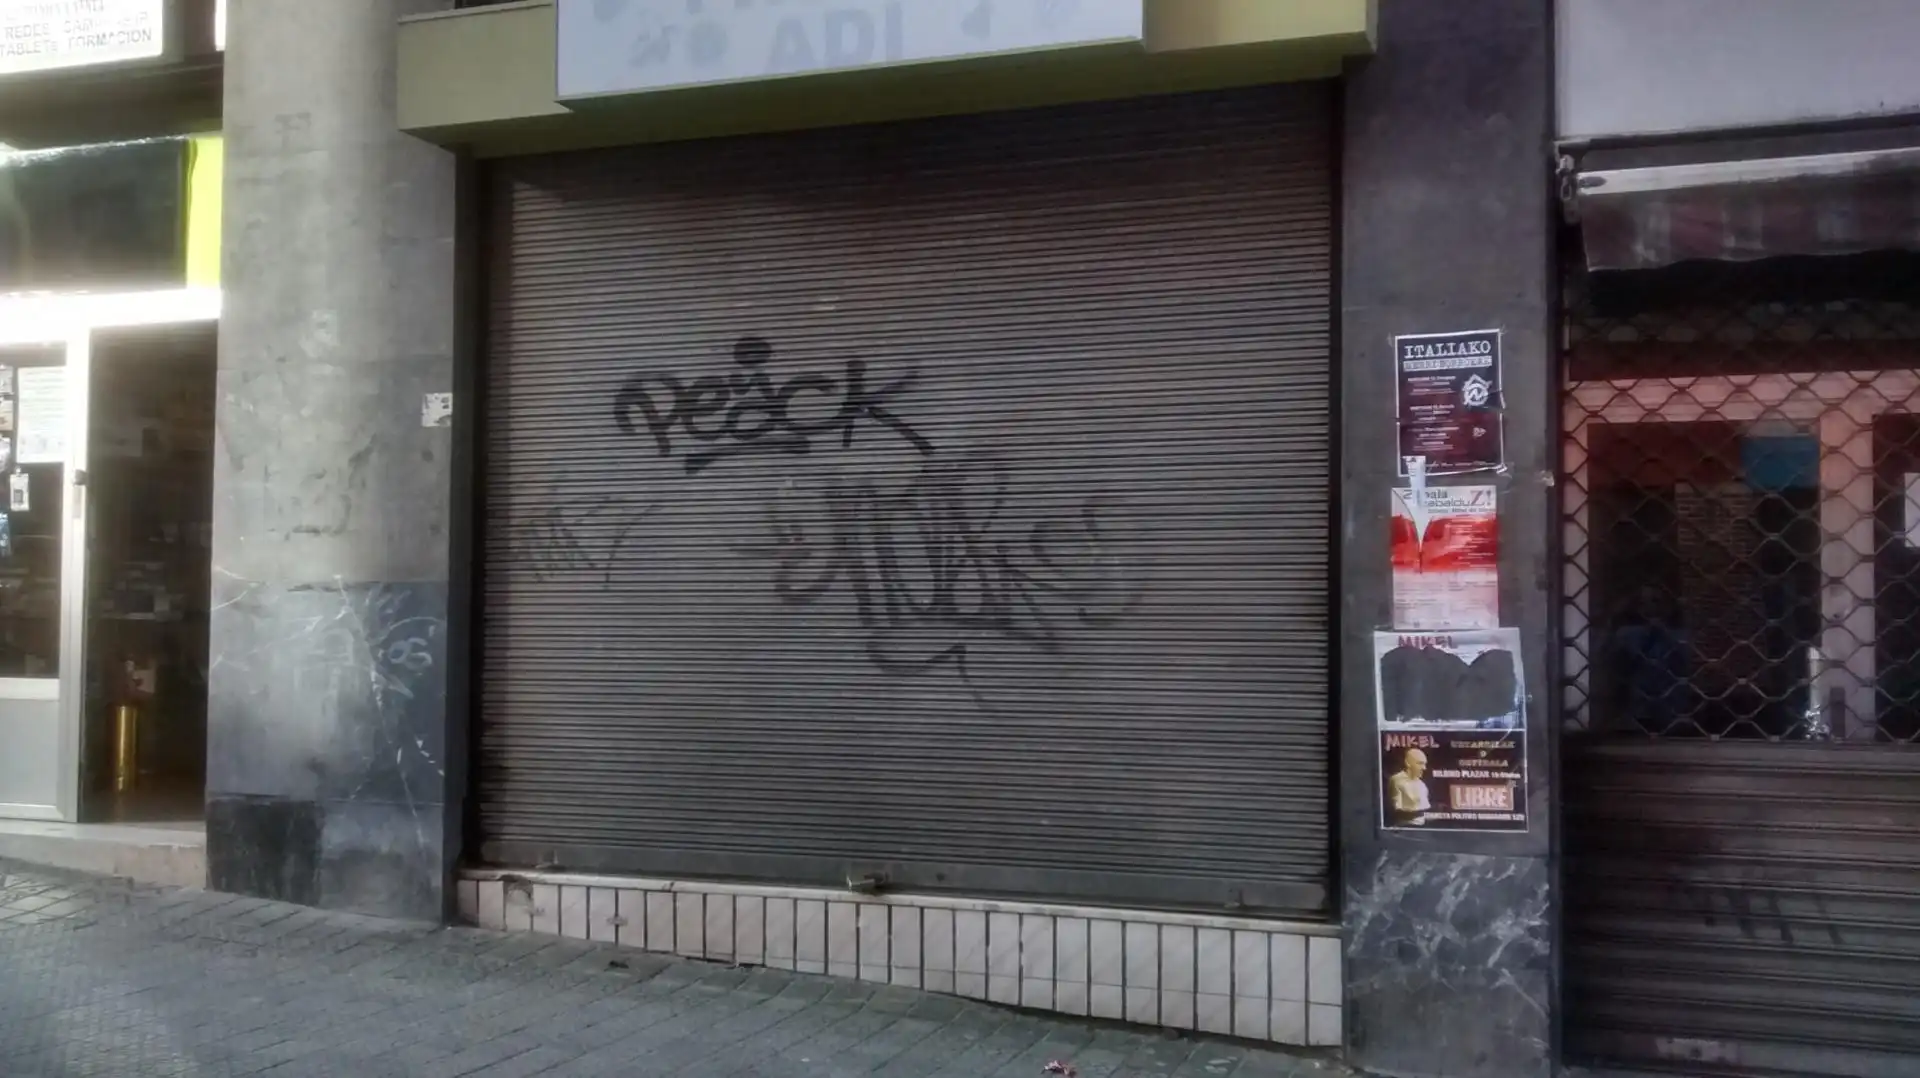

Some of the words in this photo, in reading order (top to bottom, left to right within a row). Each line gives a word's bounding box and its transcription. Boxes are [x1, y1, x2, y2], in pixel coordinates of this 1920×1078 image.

[1404, 341, 1491, 359] ITALIAKO
[1385, 733, 1440, 751] MIKEL
[1456, 787, 1508, 808] LIBRE
